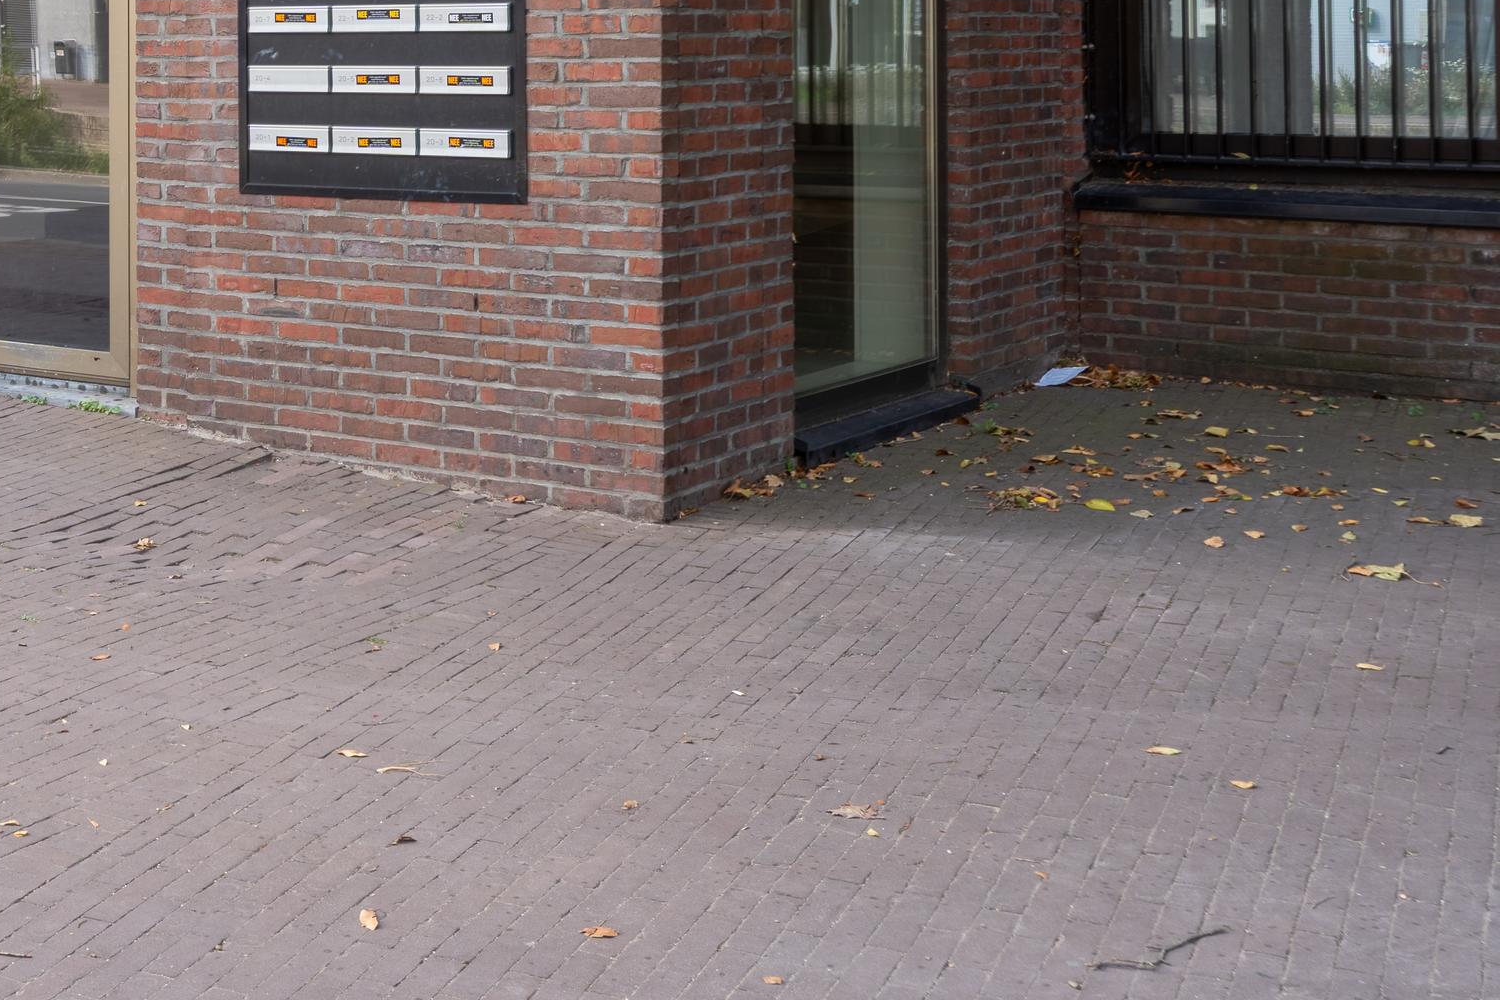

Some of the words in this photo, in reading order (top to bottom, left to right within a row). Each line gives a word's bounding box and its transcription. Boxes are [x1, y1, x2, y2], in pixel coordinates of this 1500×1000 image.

[358, 10, 368, 19] NEE
[389, 10, 400, 18] NEE
[449, 14, 460, 22] NEE
[482, 13, 492, 22] NEE
[449, 137, 460, 146] NEE
[483, 139, 494, 148] NEE
